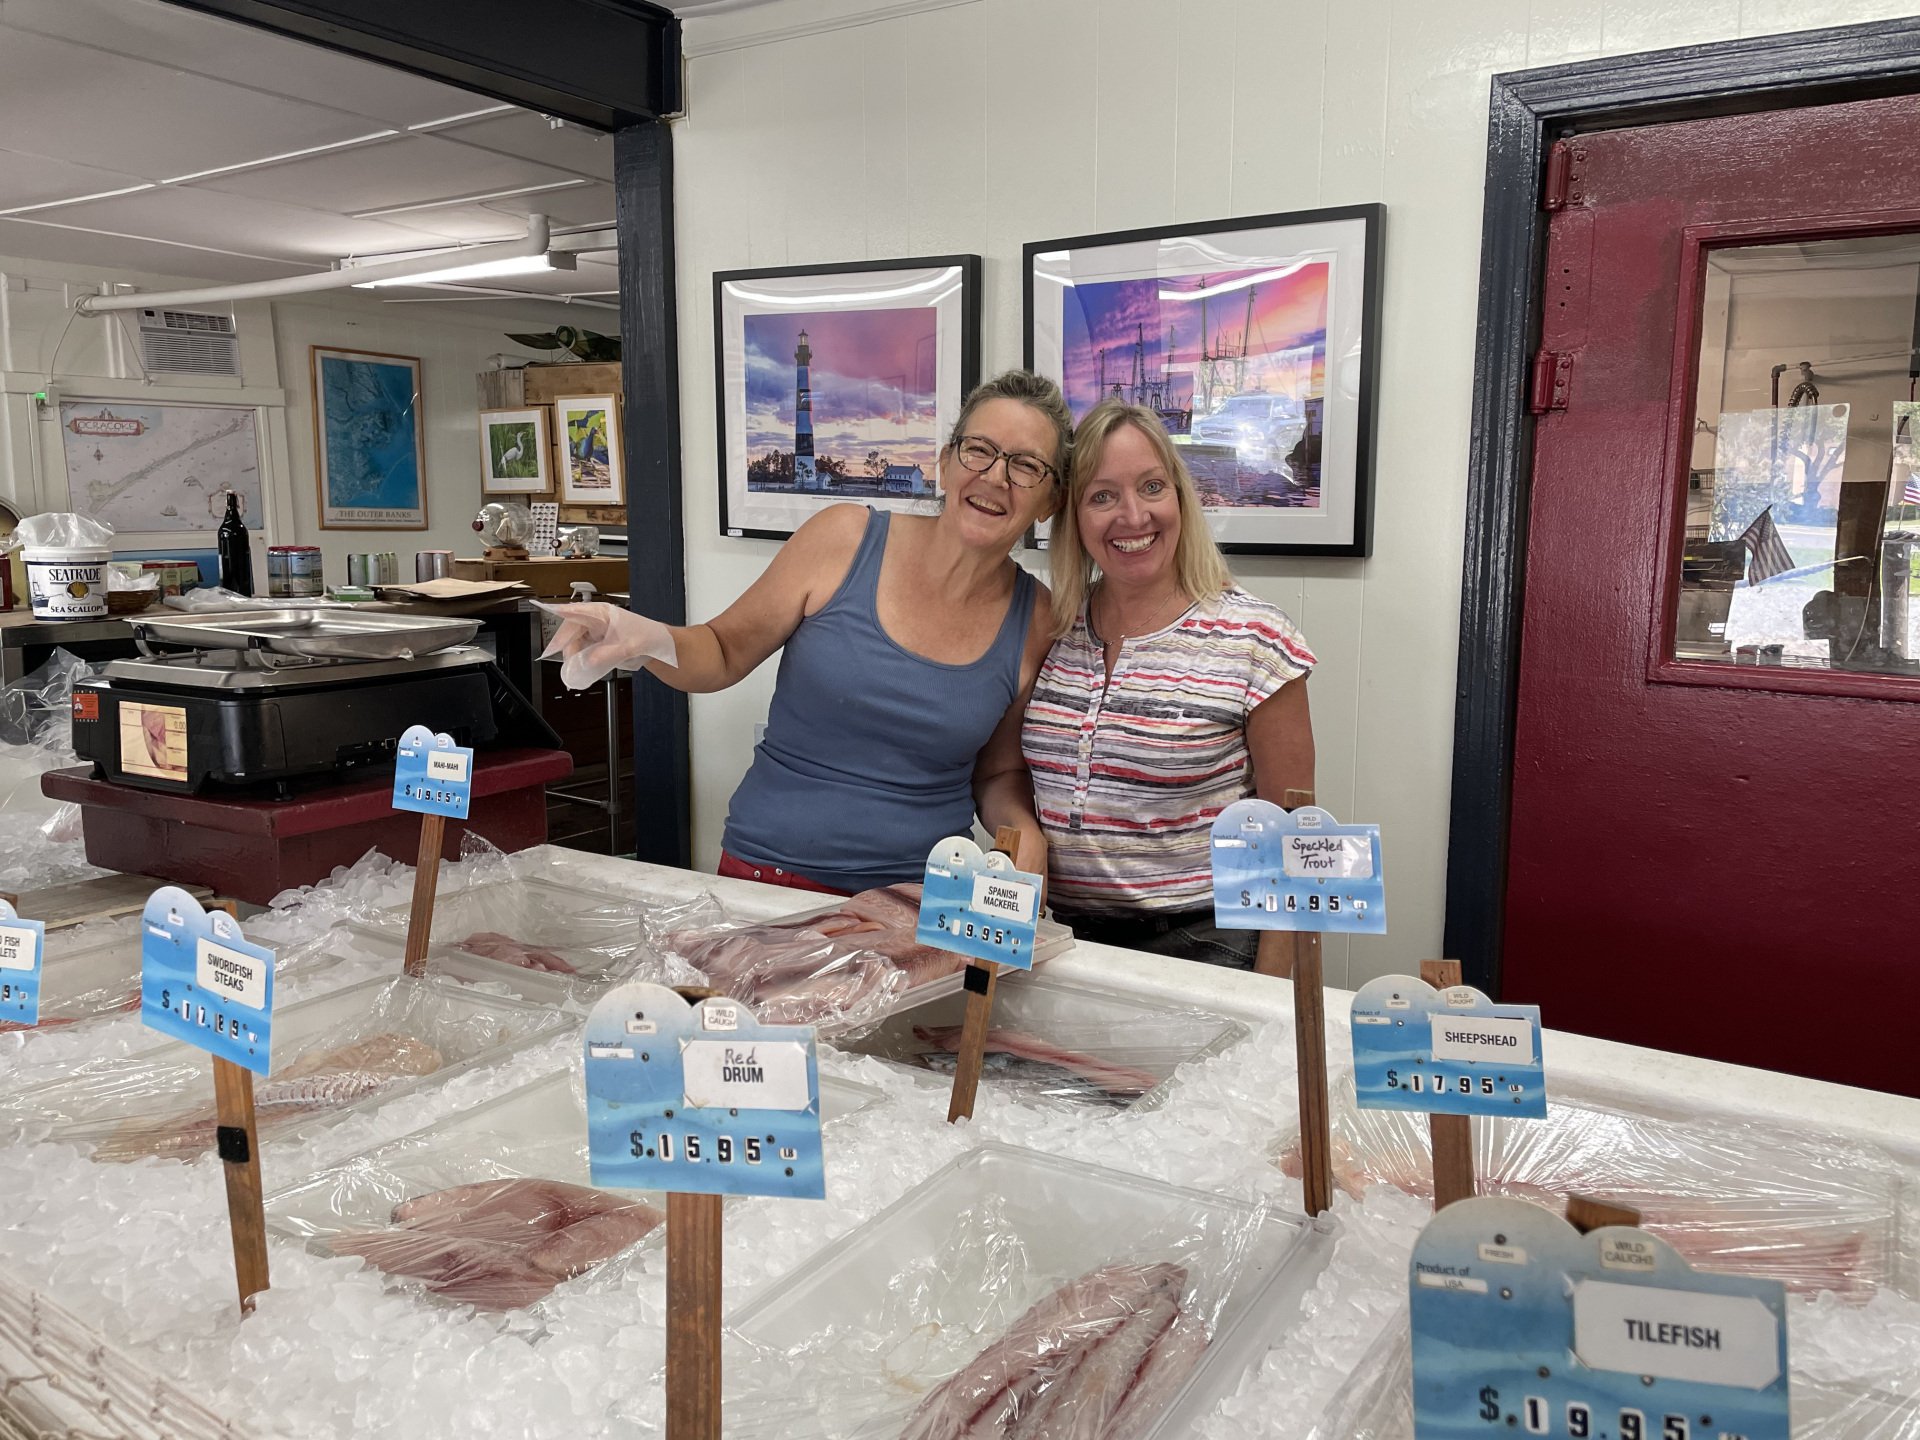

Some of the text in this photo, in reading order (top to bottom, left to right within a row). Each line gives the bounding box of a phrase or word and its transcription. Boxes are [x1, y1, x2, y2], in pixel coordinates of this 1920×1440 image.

[77, 421, 136, 431] OCRACOKE
[339, 510, 412, 519] THE OUTER BANKS
[48, 567, 101, 581] SEATRADE
[50, 605, 66, 613] SEA
[433, 761, 459, 771] MAHI-MAHI
[1292, 837, 1343, 855] Speckled
[1300, 853, 1336, 870] Trout
[988, 886, 1018, 900] SPANISH
[983, 896, 1020, 912] MACKEREL
[4, 935, 20, 947] FISH
[207, 953, 253, 981] SWORDFISH
[213, 971, 244, 992] STEAKS
[715, 1009, 735, 1018] WILD
[588, 1040, 613, 1048] Product
[1445, 1031, 1517, 1047] SHEEPSHEAD
[725, 1048, 758, 1066] Red
[723, 1066, 764, 1083] DRUM
[783, 1149, 793, 1158] LB
[1615, 1240, 1646, 1253] WILD
[1416, 1261, 1470, 1276] Product of
[1444, 1280, 1464, 1289] USA
[1624, 1318, 1721, 1351] TILEFISH
